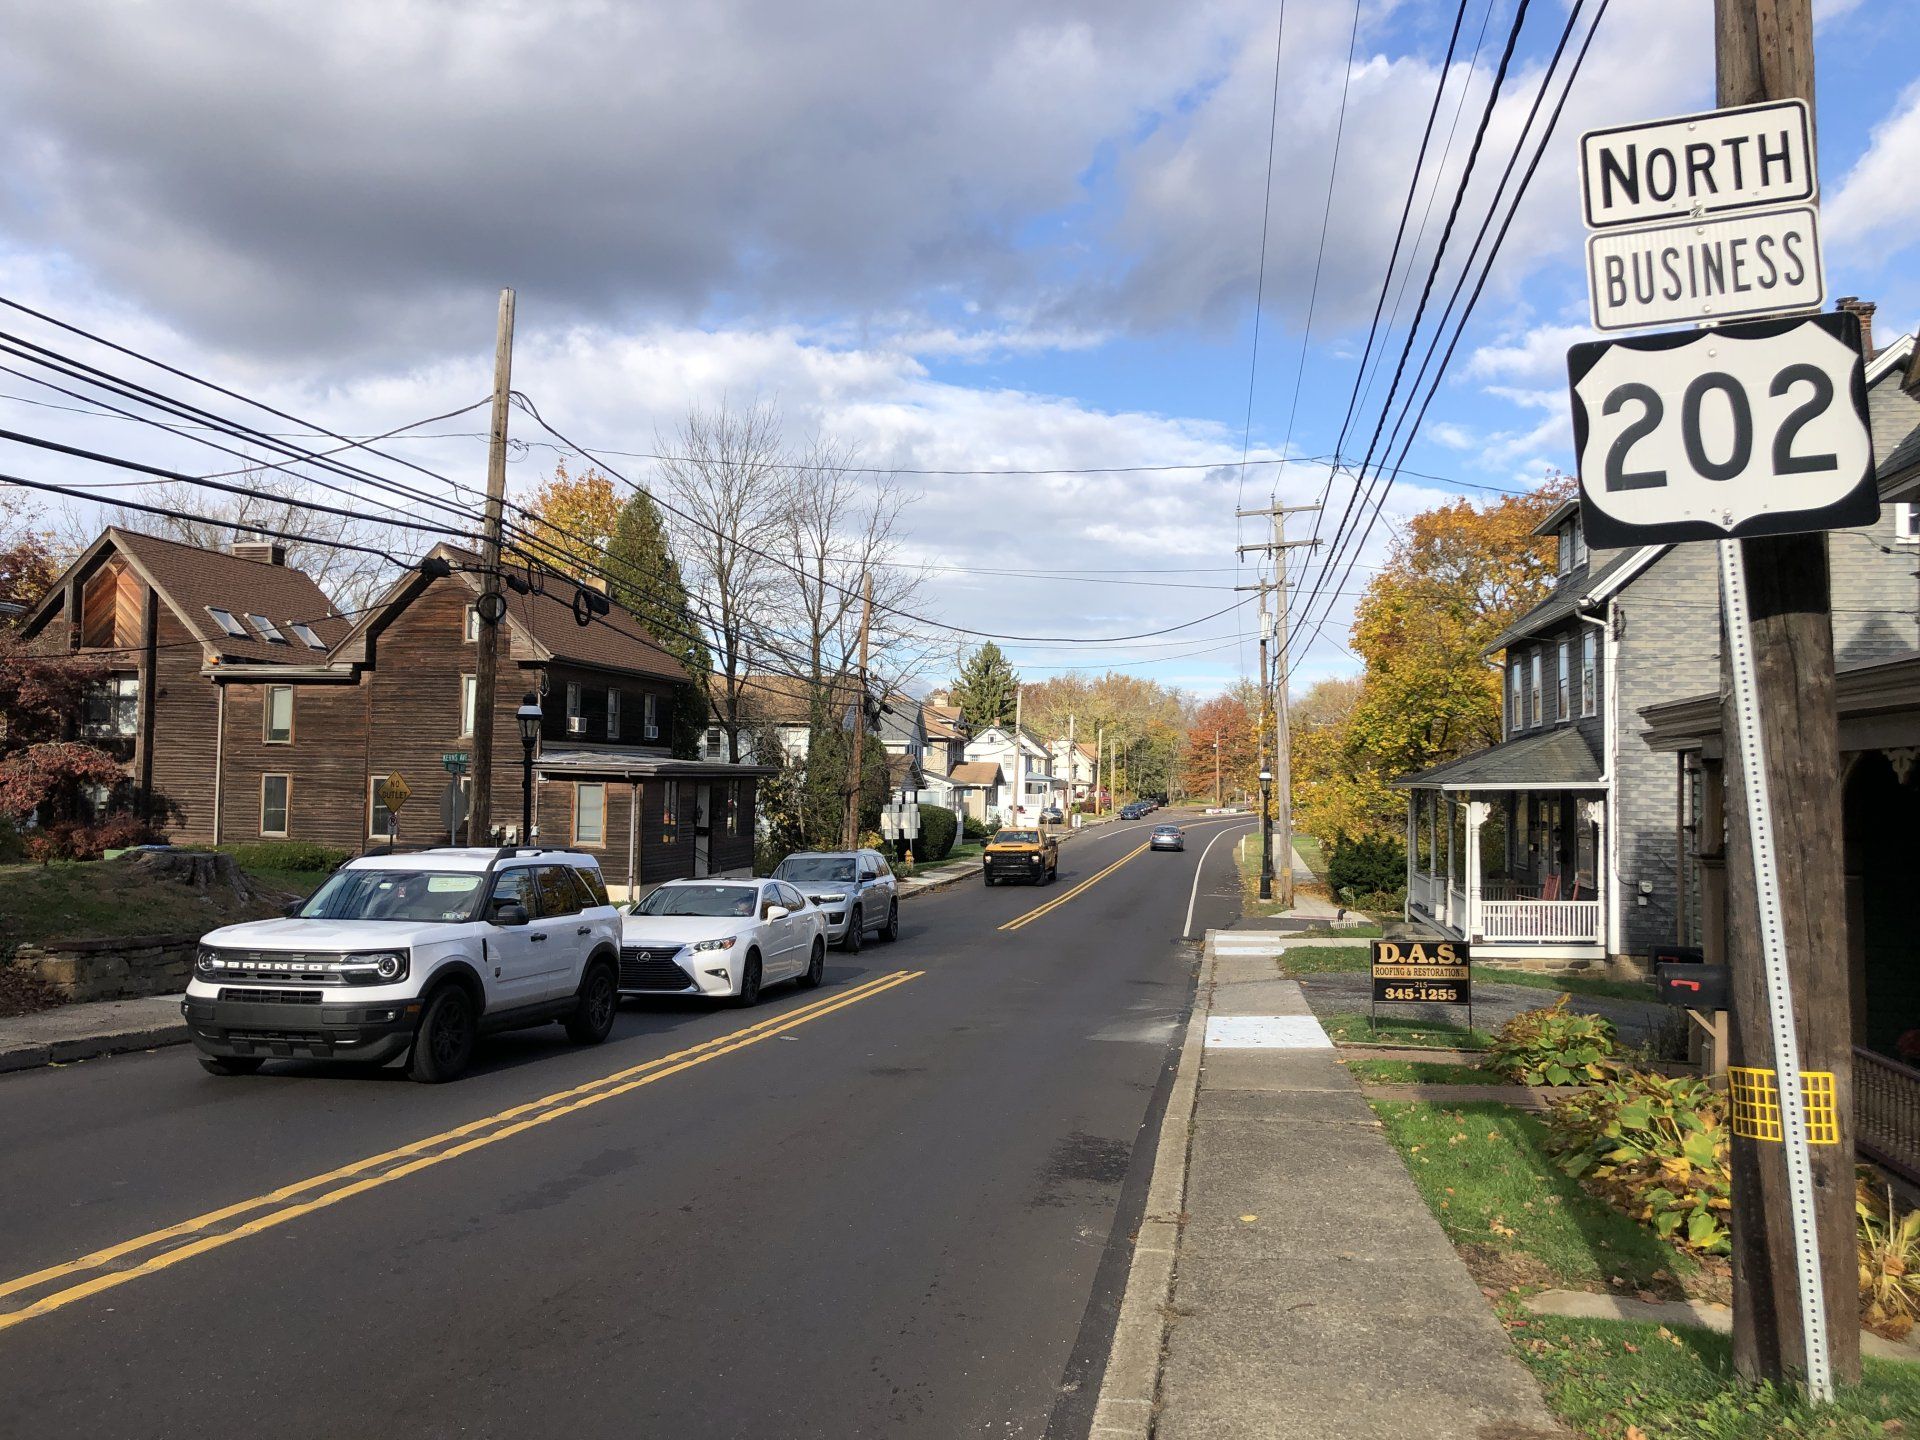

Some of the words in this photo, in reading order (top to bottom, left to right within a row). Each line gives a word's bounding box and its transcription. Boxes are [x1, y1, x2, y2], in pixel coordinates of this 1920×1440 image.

[1599, 130, 1791, 208] NORTH
[1605, 231, 1805, 308] BUSINESS
[1602, 363, 1838, 493] 202
[382, 791, 407, 799] OUTLET
[1378, 943, 1462, 965] D.A.S.
[227, 961, 323, 971] BRONCO
[1375, 966, 1405, 976] ROOFING
[1406, 967, 1412, 976] &
[1413, 967, 1460, 977] RESTORATION
[1385, 987, 1458, 1000] 345-1255
